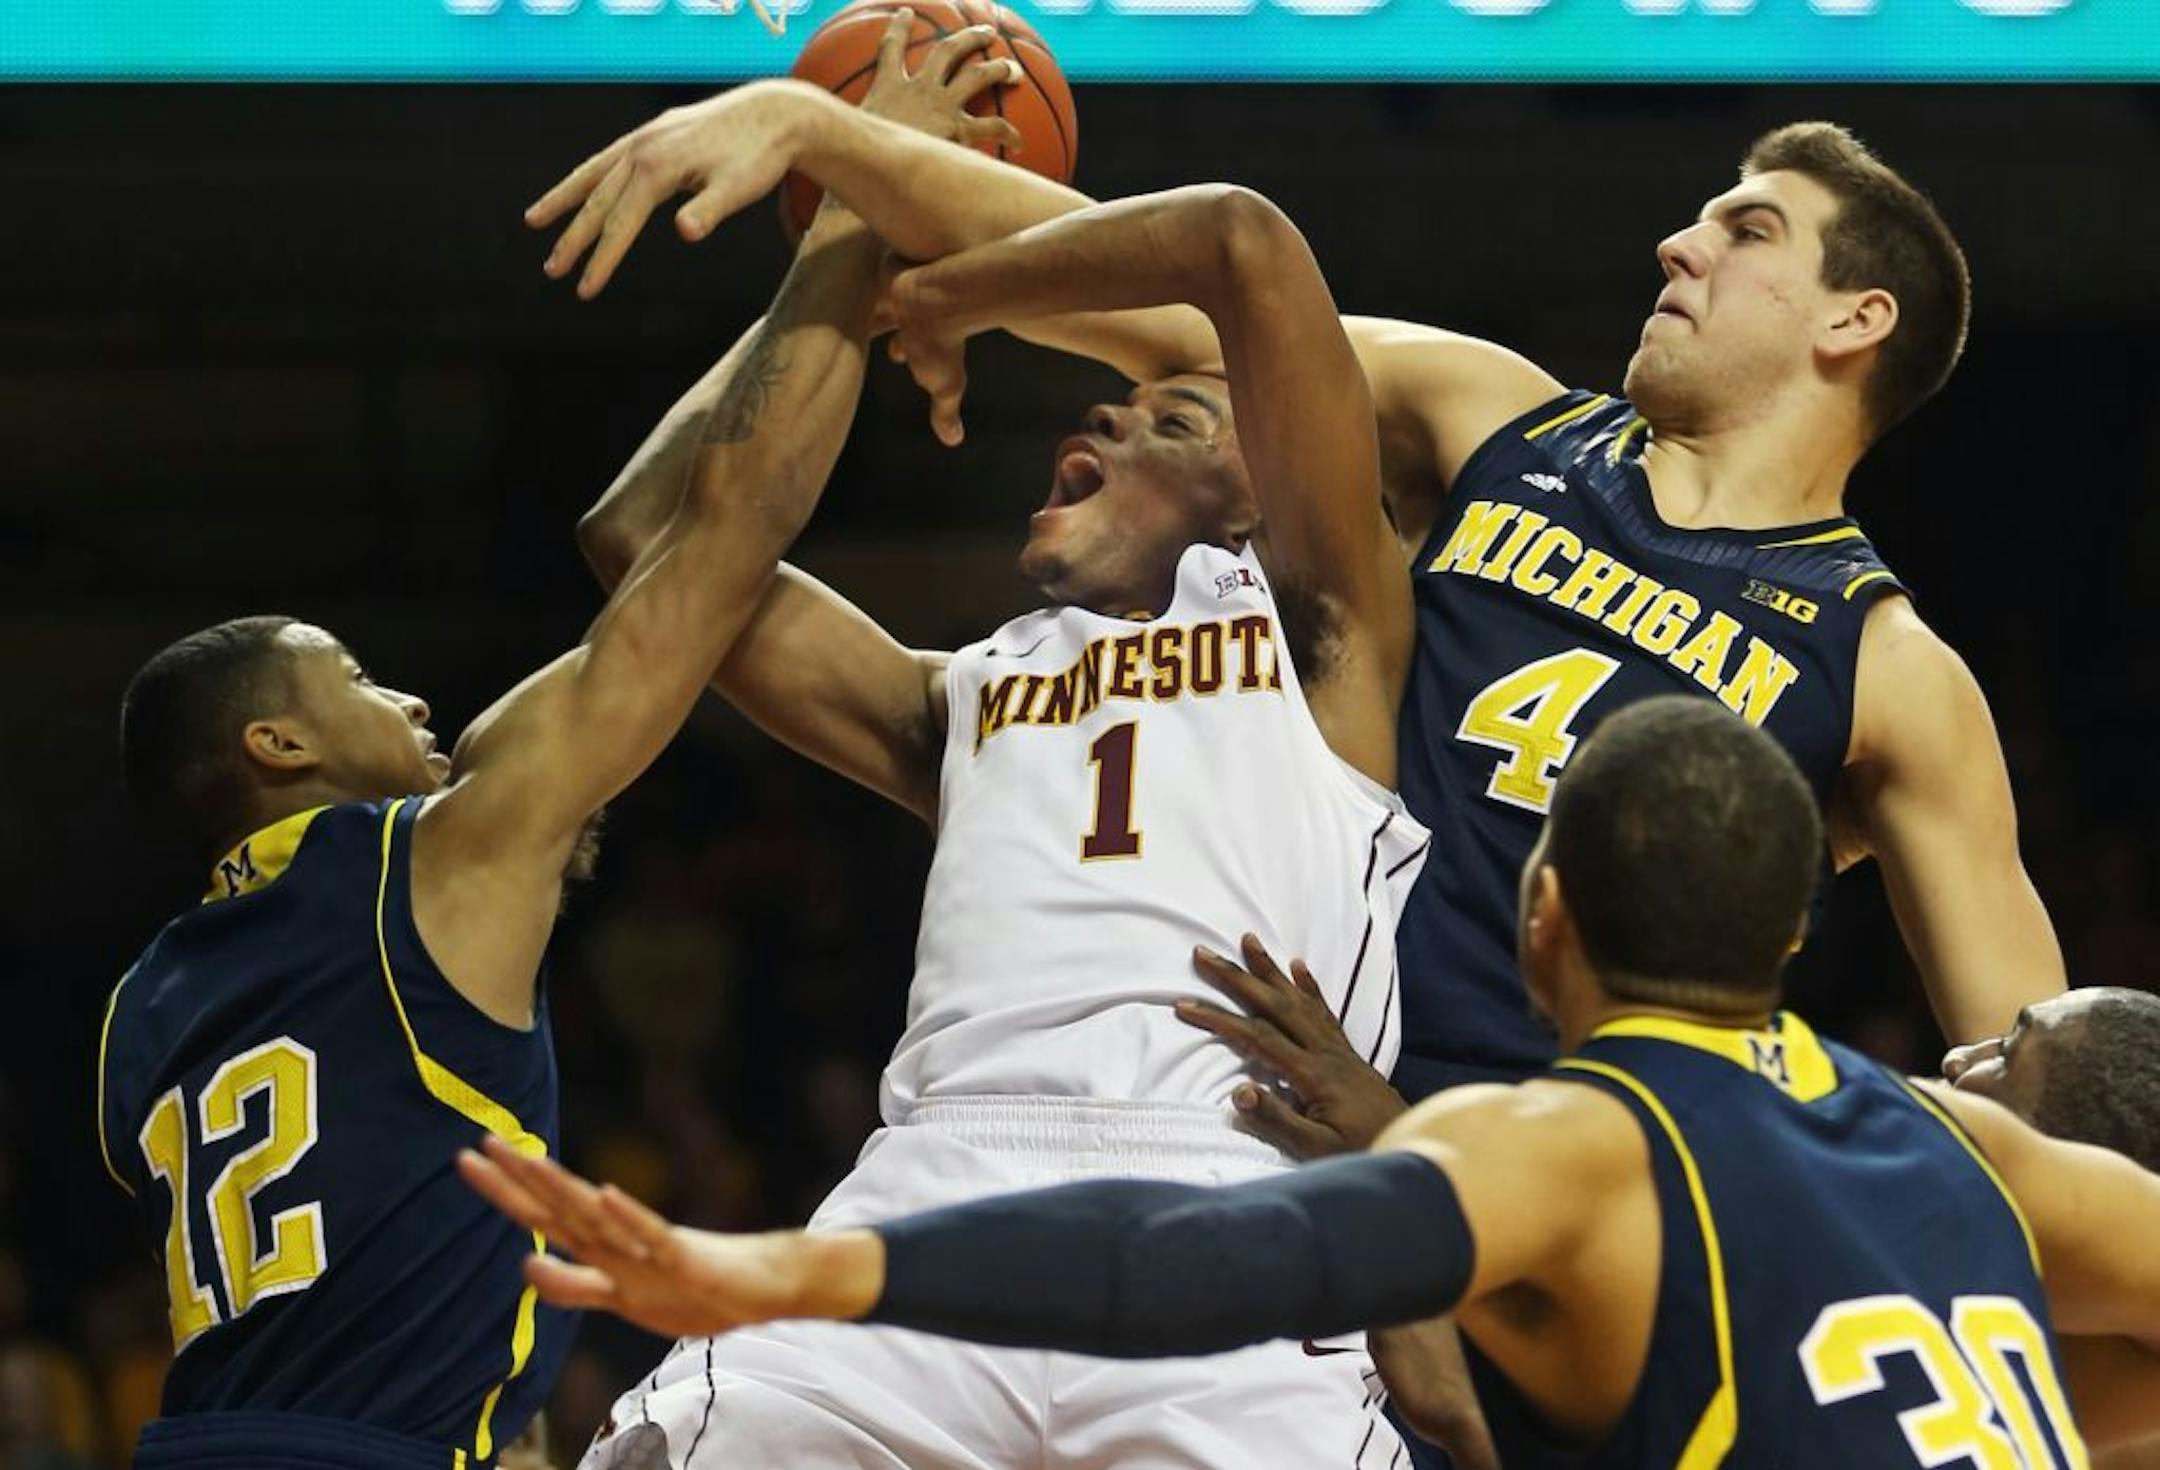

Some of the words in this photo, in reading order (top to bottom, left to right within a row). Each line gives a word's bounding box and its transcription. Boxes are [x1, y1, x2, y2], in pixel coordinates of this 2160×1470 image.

[1428, 500, 1800, 731] MICHIGAN
[1080, 720, 1144, 863] 1
[1455, 647, 1621, 816] 4
[219, 841, 257, 898] M
[1745, 1036, 1791, 1084] M
[139, 1035, 327, 1358] 12
[1798, 1294, 2091, 1470] 30
